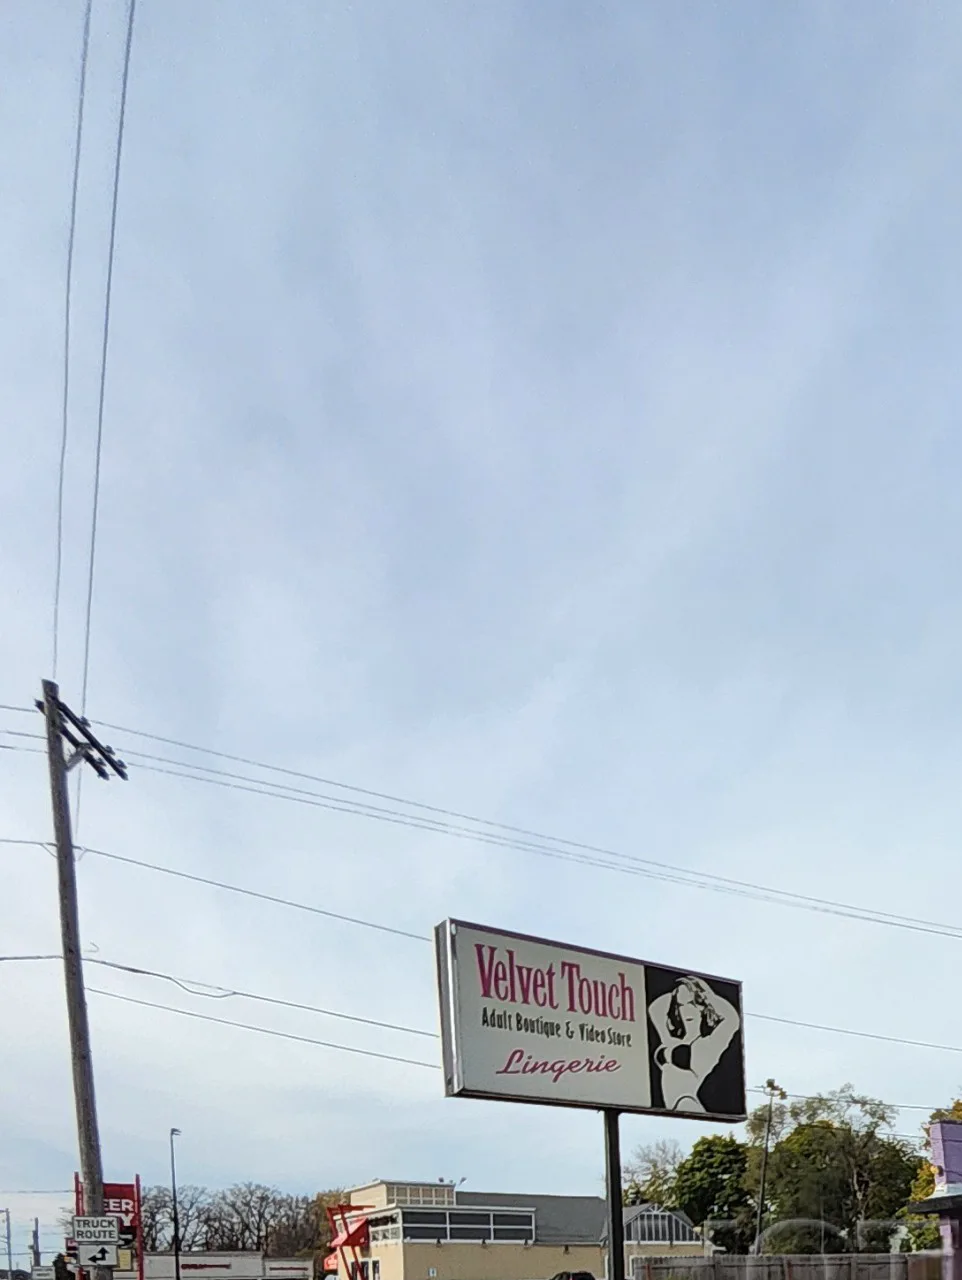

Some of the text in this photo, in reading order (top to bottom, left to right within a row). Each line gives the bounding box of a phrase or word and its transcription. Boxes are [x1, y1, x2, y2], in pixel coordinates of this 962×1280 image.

[474, 943, 636, 1022] Velvet Touch
[482, 1006, 632, 1048] Adult Boutique & Video Store
[496, 1049, 621, 1083] Lingerie
[76, 1219, 116, 1229] TRUCK
[76, 1230, 116, 1239] ROUTE
